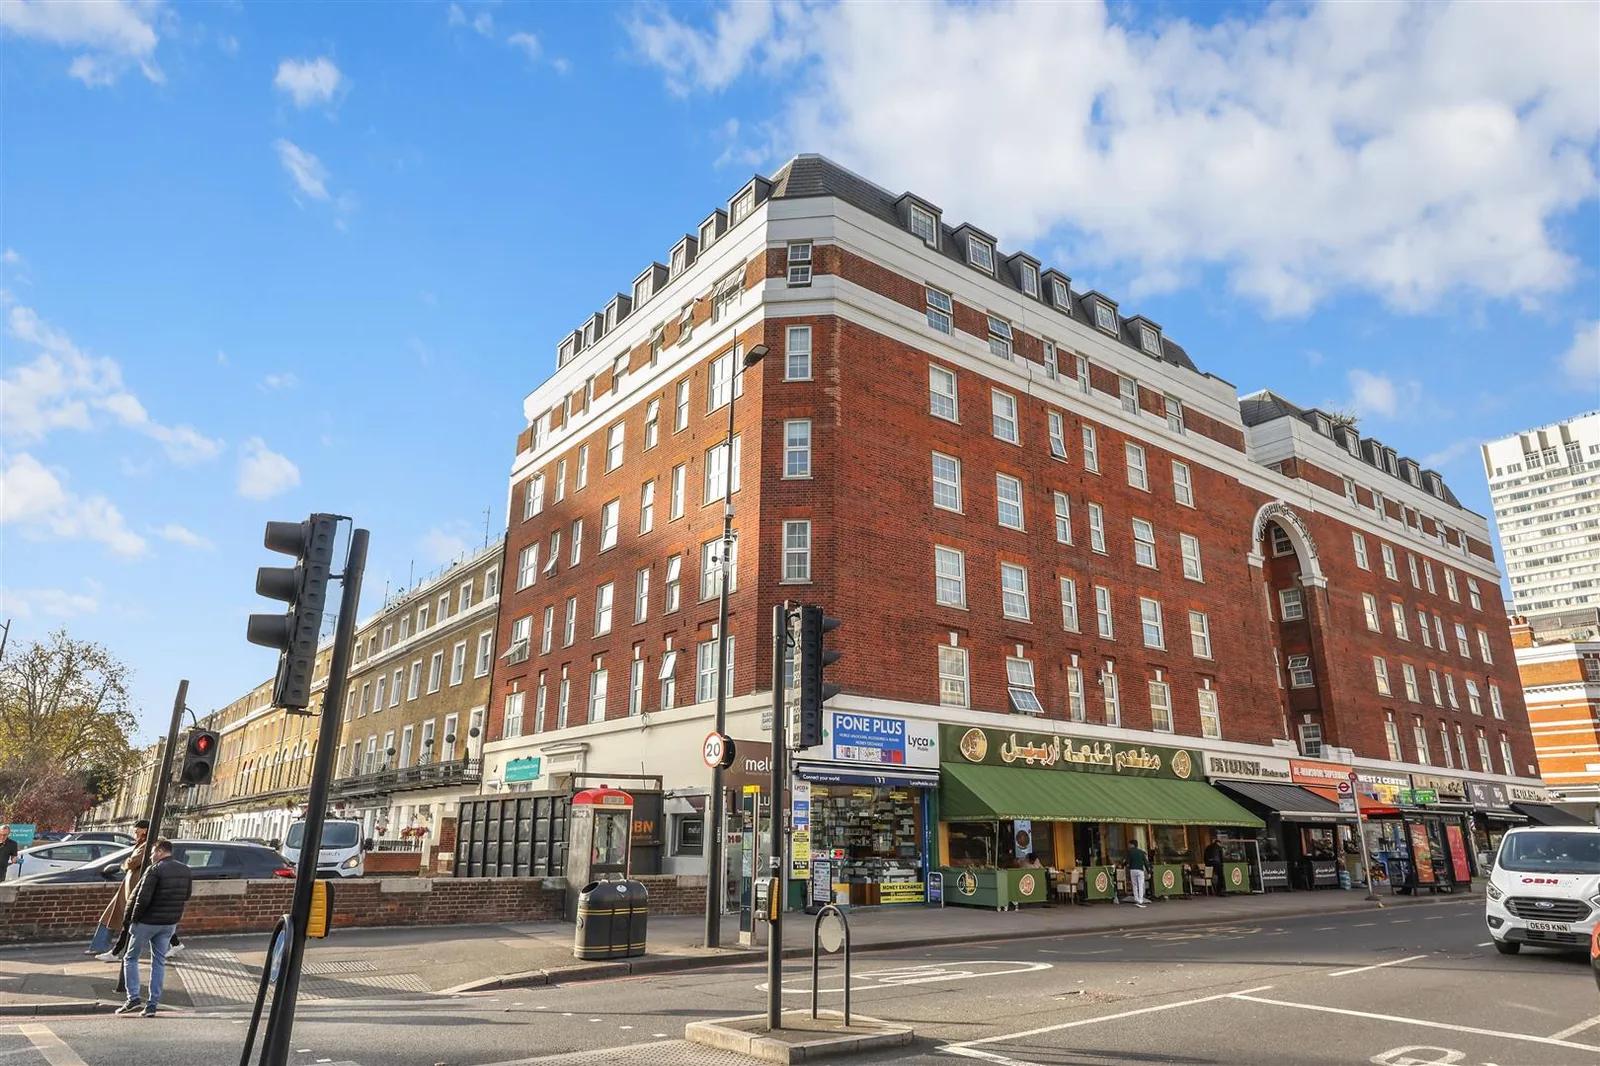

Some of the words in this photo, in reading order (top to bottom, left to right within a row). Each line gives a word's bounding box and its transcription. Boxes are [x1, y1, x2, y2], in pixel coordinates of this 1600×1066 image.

[836, 715, 870, 732] FONE
[873, 719, 902, 735] PLUS
[908, 735, 928, 747] Lyca
[706, 743, 720, 757] 20
[1358, 775, 1376, 783] WEST
[1382, 778, 1407, 787] CENTRE
[632, 820, 654, 833] BN
[1551, 924, 1568, 932] KNN
